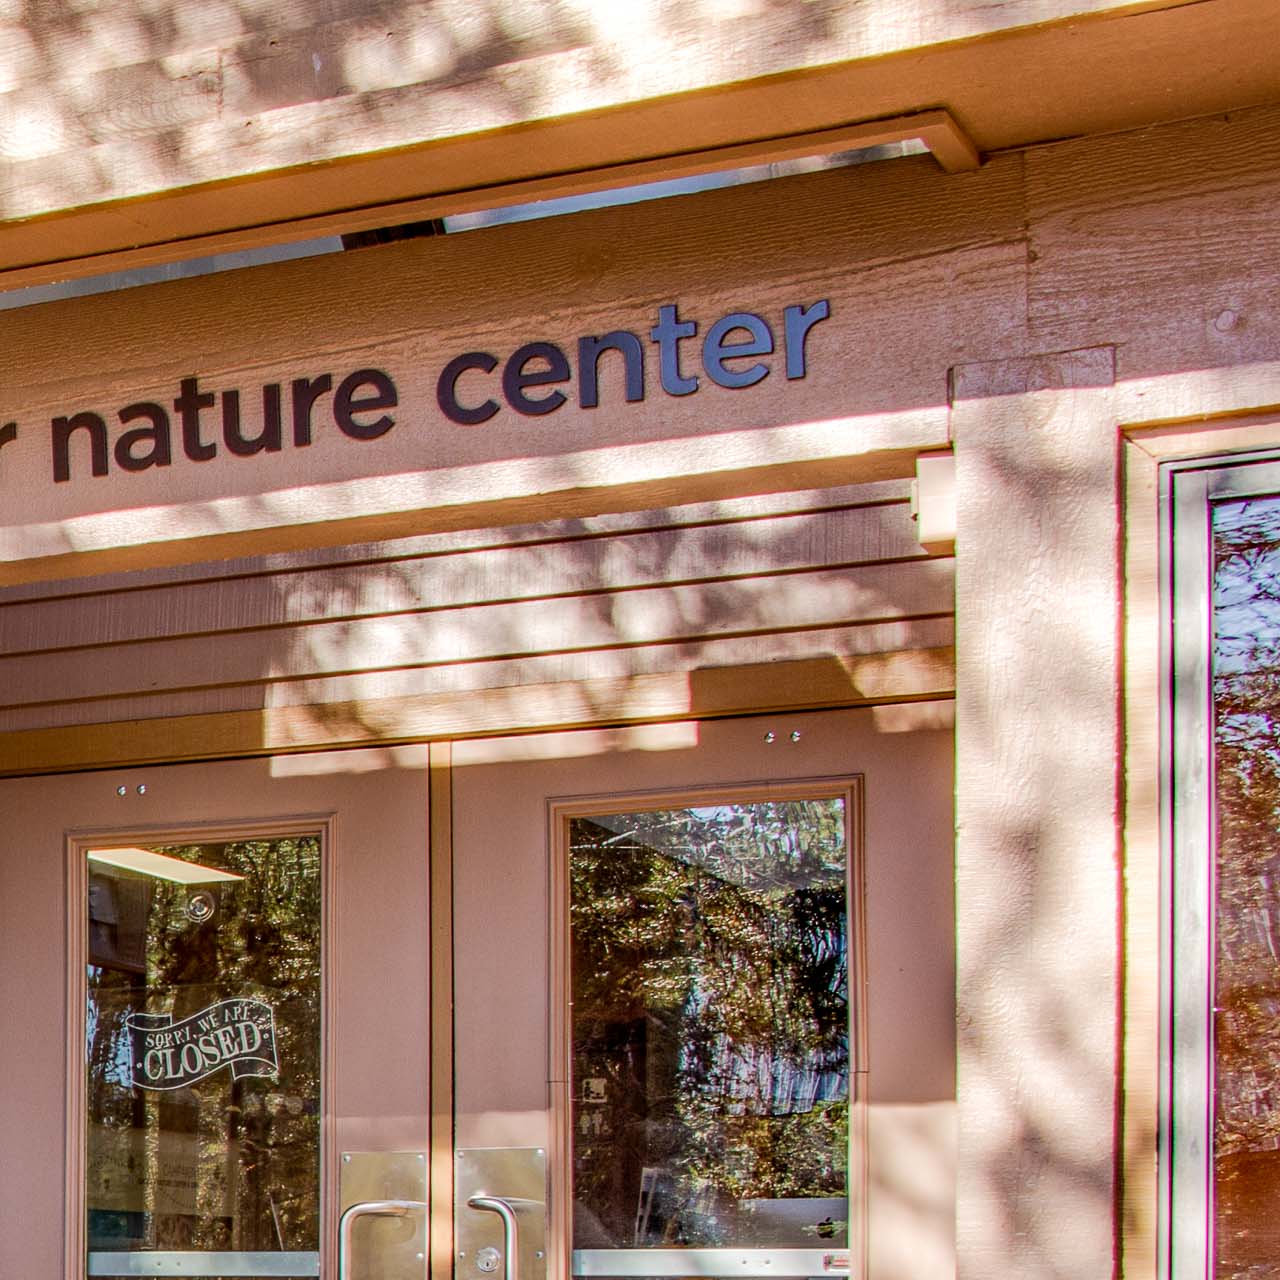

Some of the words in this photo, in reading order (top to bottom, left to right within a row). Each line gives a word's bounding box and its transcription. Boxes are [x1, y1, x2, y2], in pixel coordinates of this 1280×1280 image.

[50, 367, 399, 483] nature
[436, 299, 830, 426] center
[144, 1022, 261, 1080] CLOSED
